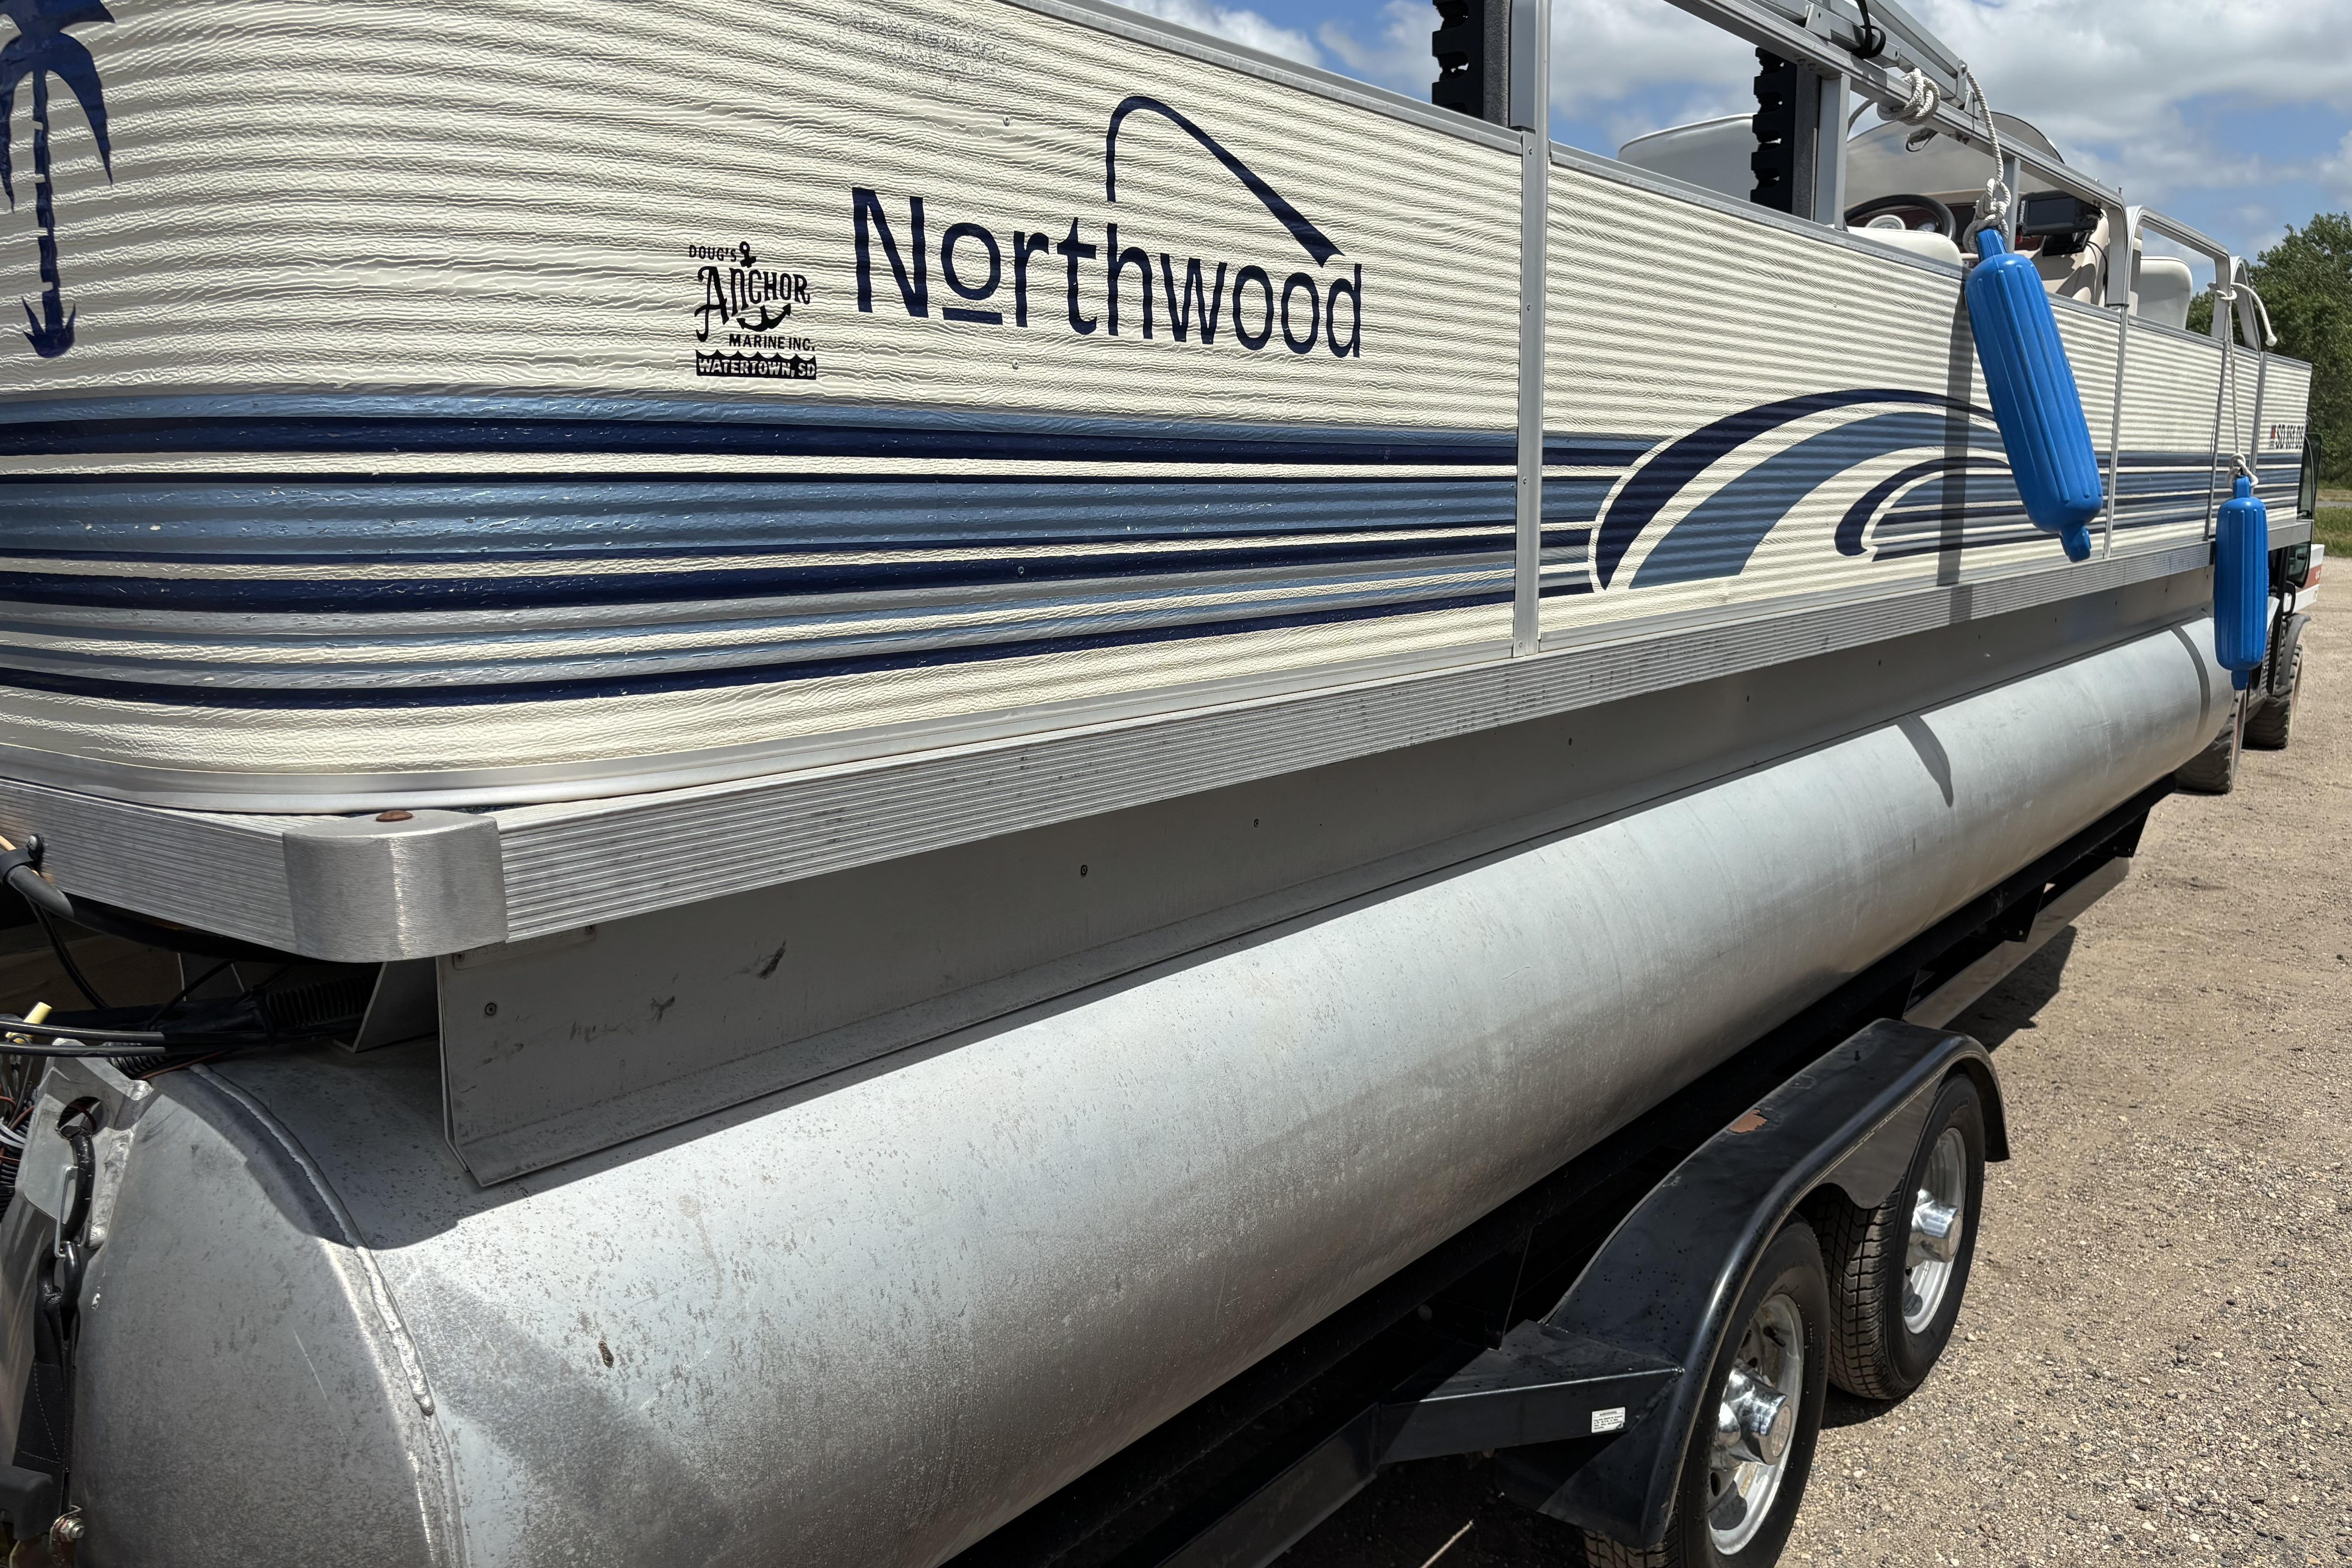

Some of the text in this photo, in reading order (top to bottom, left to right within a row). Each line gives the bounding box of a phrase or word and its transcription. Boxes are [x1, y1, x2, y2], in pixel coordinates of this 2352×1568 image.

[689, 245, 736, 262] DOUG'S
[852, 187, 1362, 358] Northwood
[695, 266, 810, 342] ANCHOR
[729, 334, 815, 351] MARINE INC.
[698, 359, 815, 377] WATERTOWN, SD
